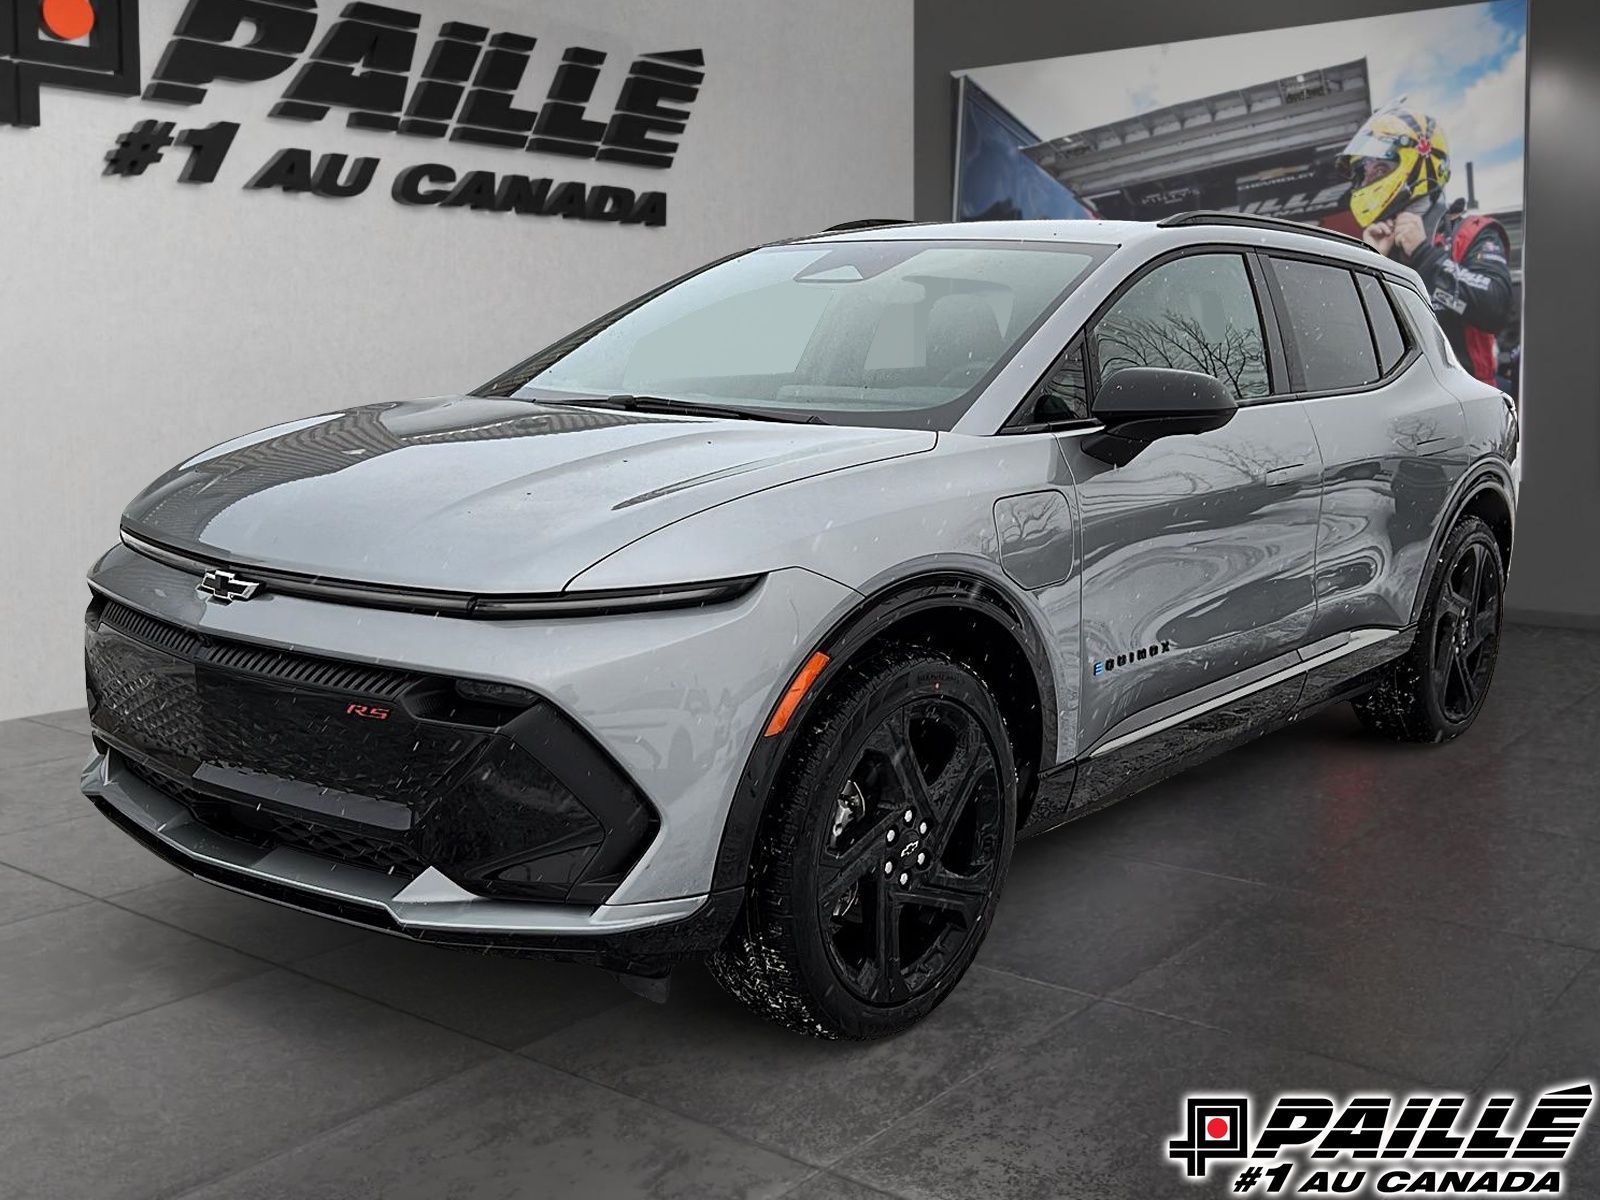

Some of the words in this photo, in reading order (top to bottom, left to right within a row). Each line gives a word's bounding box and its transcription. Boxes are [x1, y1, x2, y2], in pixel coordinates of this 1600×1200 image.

[141, 0, 704, 169] PAILLÉ
[102, 119, 241, 184] #1
[243, 148, 381, 198] AU
[391, 163, 668, 226] CANADA
[1093, 640, 1171, 677] EQUINOX
[346, 704, 390, 720] RS
